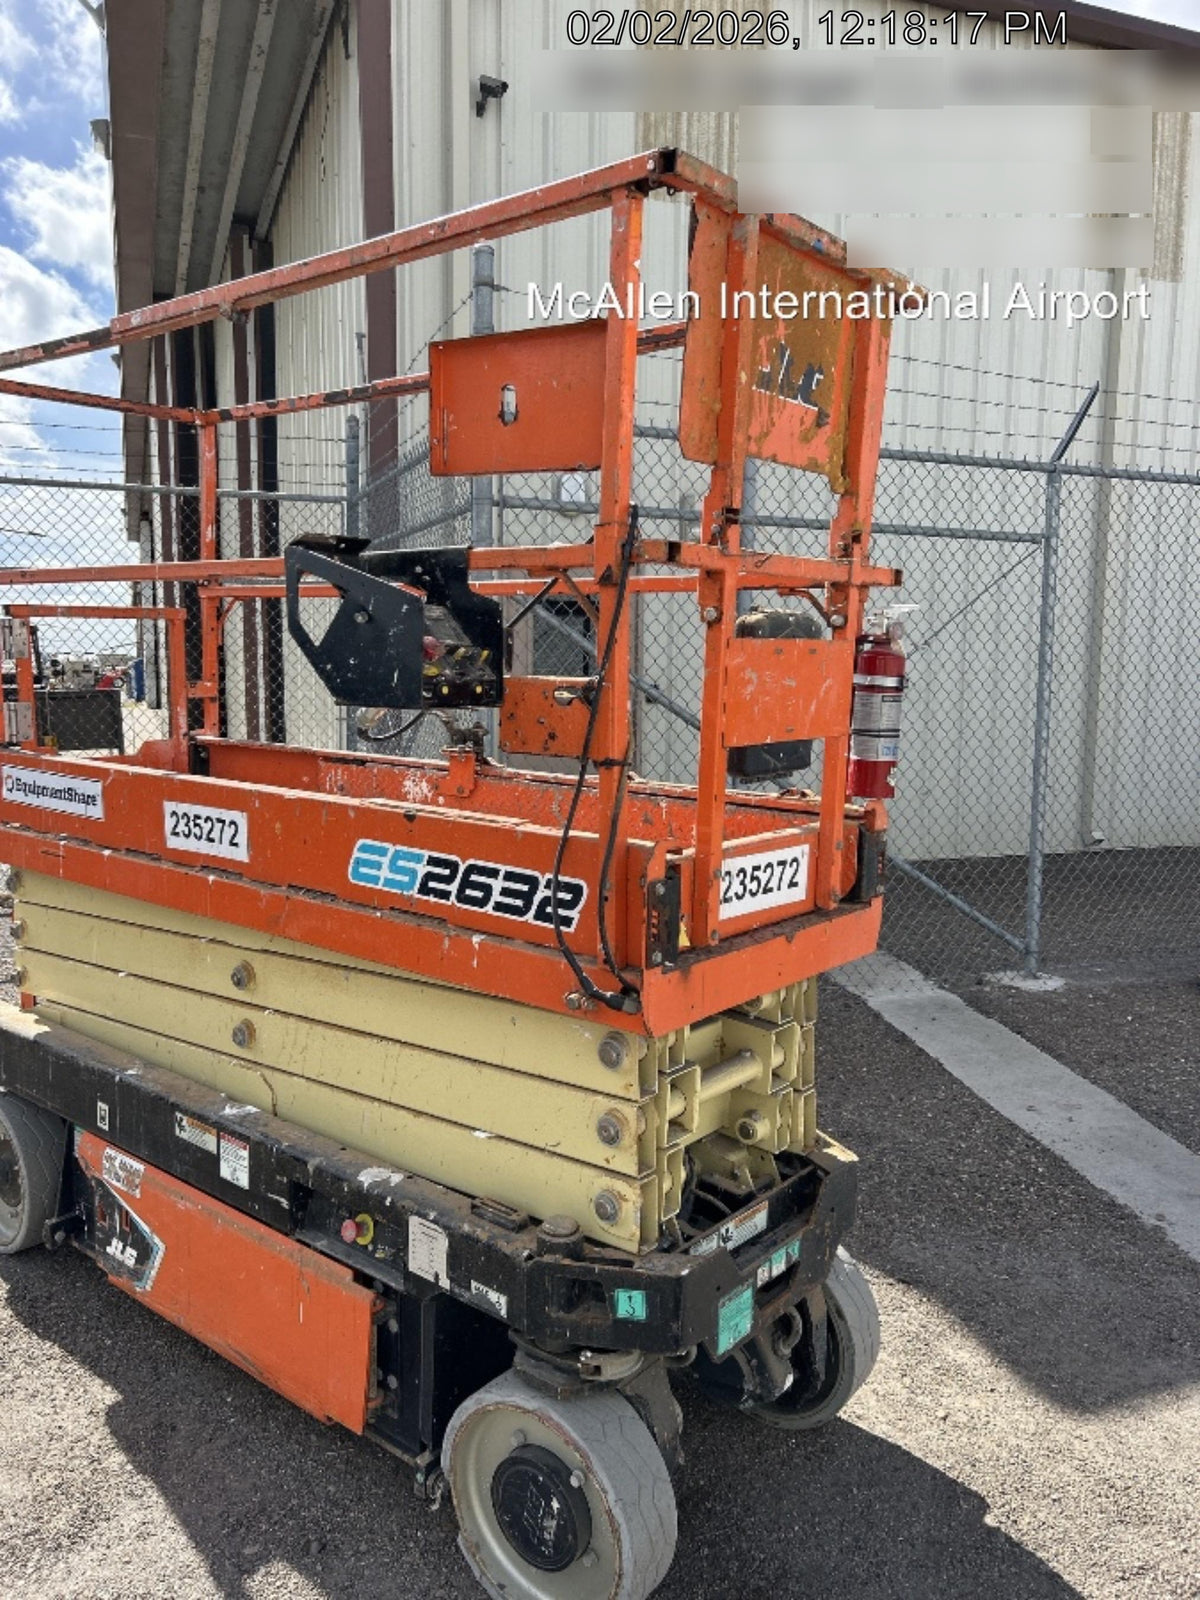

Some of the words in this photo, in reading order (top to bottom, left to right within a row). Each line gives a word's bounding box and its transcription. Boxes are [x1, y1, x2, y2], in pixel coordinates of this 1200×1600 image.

[169, 810, 240, 848] 235272
[349, 839, 588, 932] ES2632
[722, 856, 800, 904] 235272
